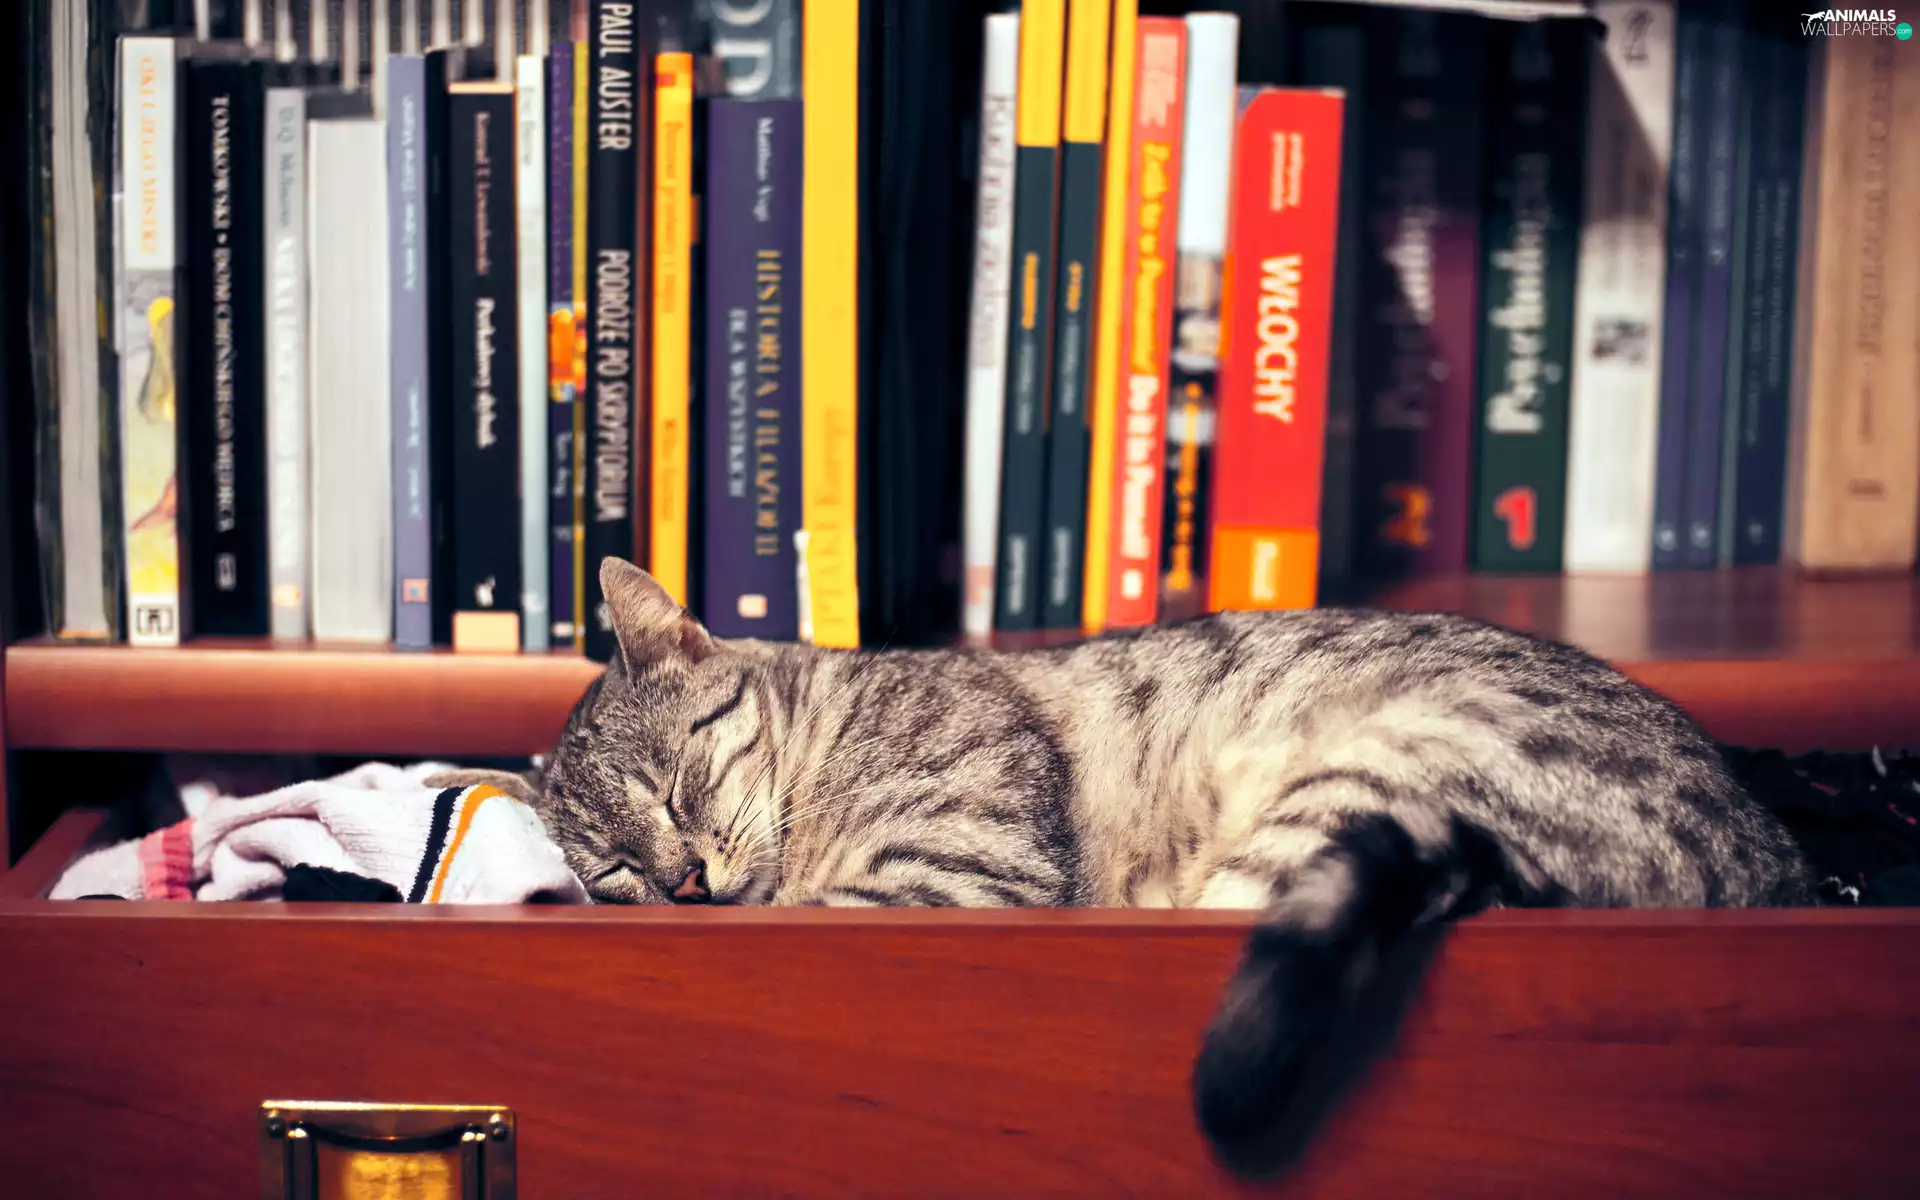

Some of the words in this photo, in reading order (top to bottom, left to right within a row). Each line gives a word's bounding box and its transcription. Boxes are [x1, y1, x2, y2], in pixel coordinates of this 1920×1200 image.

[598, 3, 633, 59] PAUL
[598, 66, 633, 151] AUSTER
[211, 96, 230, 230] TOMKOWSKI
[596, 249, 635, 344] PODRÓŻE
[755, 249, 782, 397] HISTORIA
[1252, 252, 1304, 425] WŁOCHY
[596, 347, 631, 378] PO
[1128, 375, 1160, 412] Do
[595, 380, 630, 522] SKRYPTORIUM
[1494, 486, 1537, 550] 1
